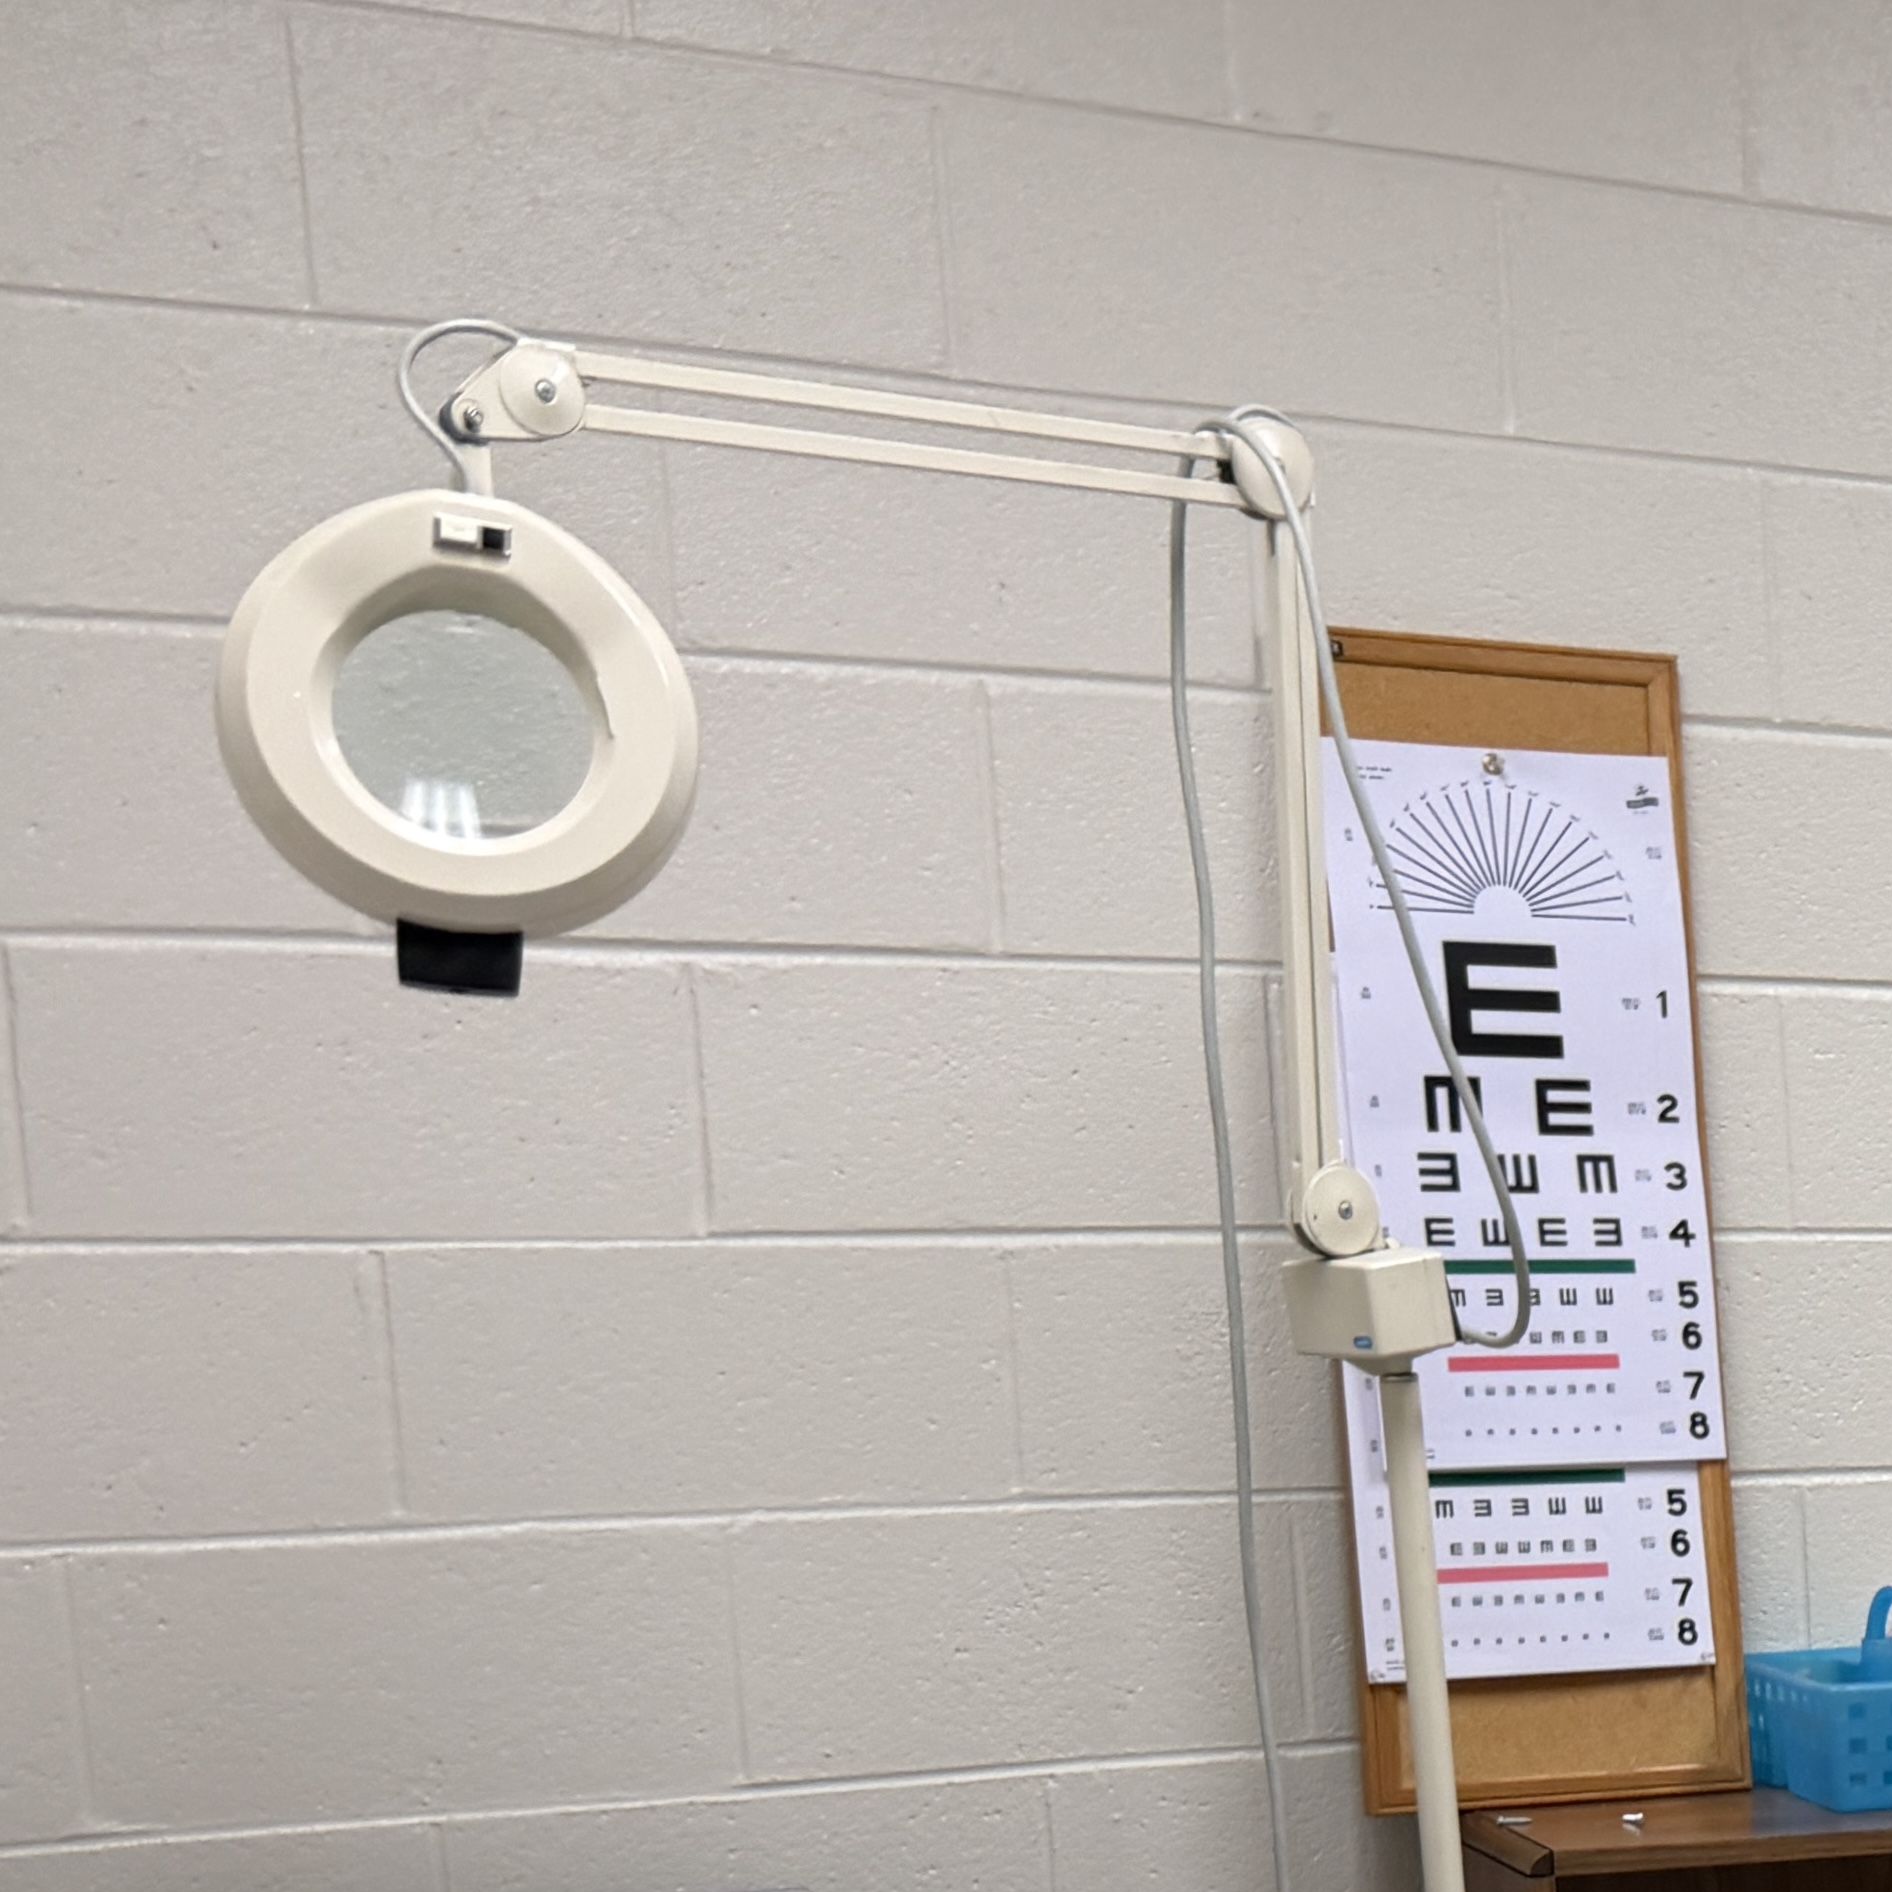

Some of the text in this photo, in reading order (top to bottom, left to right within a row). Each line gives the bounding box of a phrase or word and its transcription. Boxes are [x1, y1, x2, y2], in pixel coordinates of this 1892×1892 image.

[1442, 941, 1668, 1059] E 1
[1535, 1078, 1593, 1136] E
[1657, 1094, 1680, 1123] 2
[1665, 1162, 1688, 1191] 3
[1669, 1219, 1695, 1247] 4
[1678, 1281, 1699, 1309] 5
[1682, 1322, 1702, 1350] 6
[1683, 1371, 1705, 1400] 7
[1689, 1412, 1710, 1440] 8
[1667, 1488, 1687, 1516] 5
[1671, 1529, 1690, 1557] 6
[1671, 1578, 1693, 1606] 7
[1677, 1618, 1698, 1646] 8
